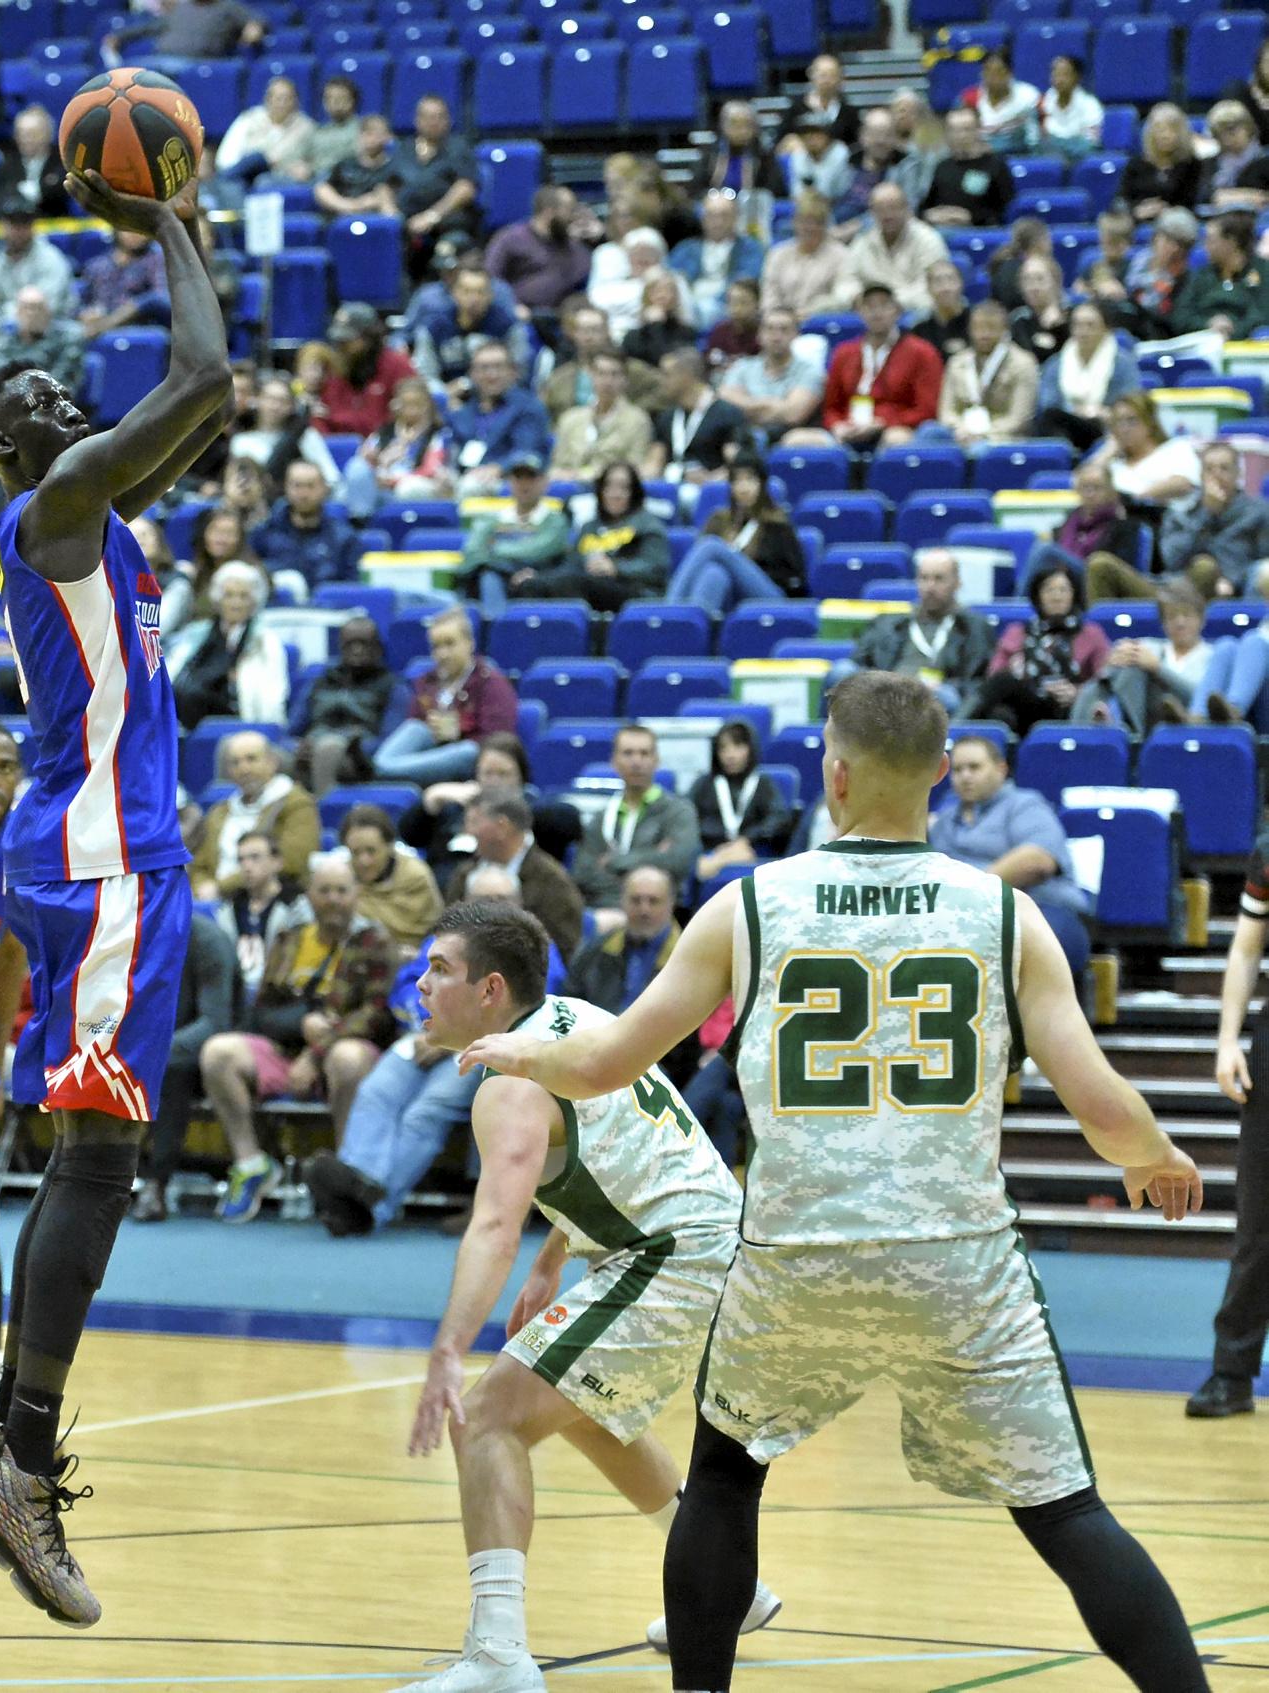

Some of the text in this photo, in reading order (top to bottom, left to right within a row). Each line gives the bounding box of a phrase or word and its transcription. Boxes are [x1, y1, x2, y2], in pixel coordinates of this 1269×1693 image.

[816, 883, 941, 917] HARVEY
[773, 948, 986, 1117] 23
[631, 1070, 696, 1142] 4
[580, 1373, 619, 1400] BLK
[714, 1392, 751, 1425] BLK
